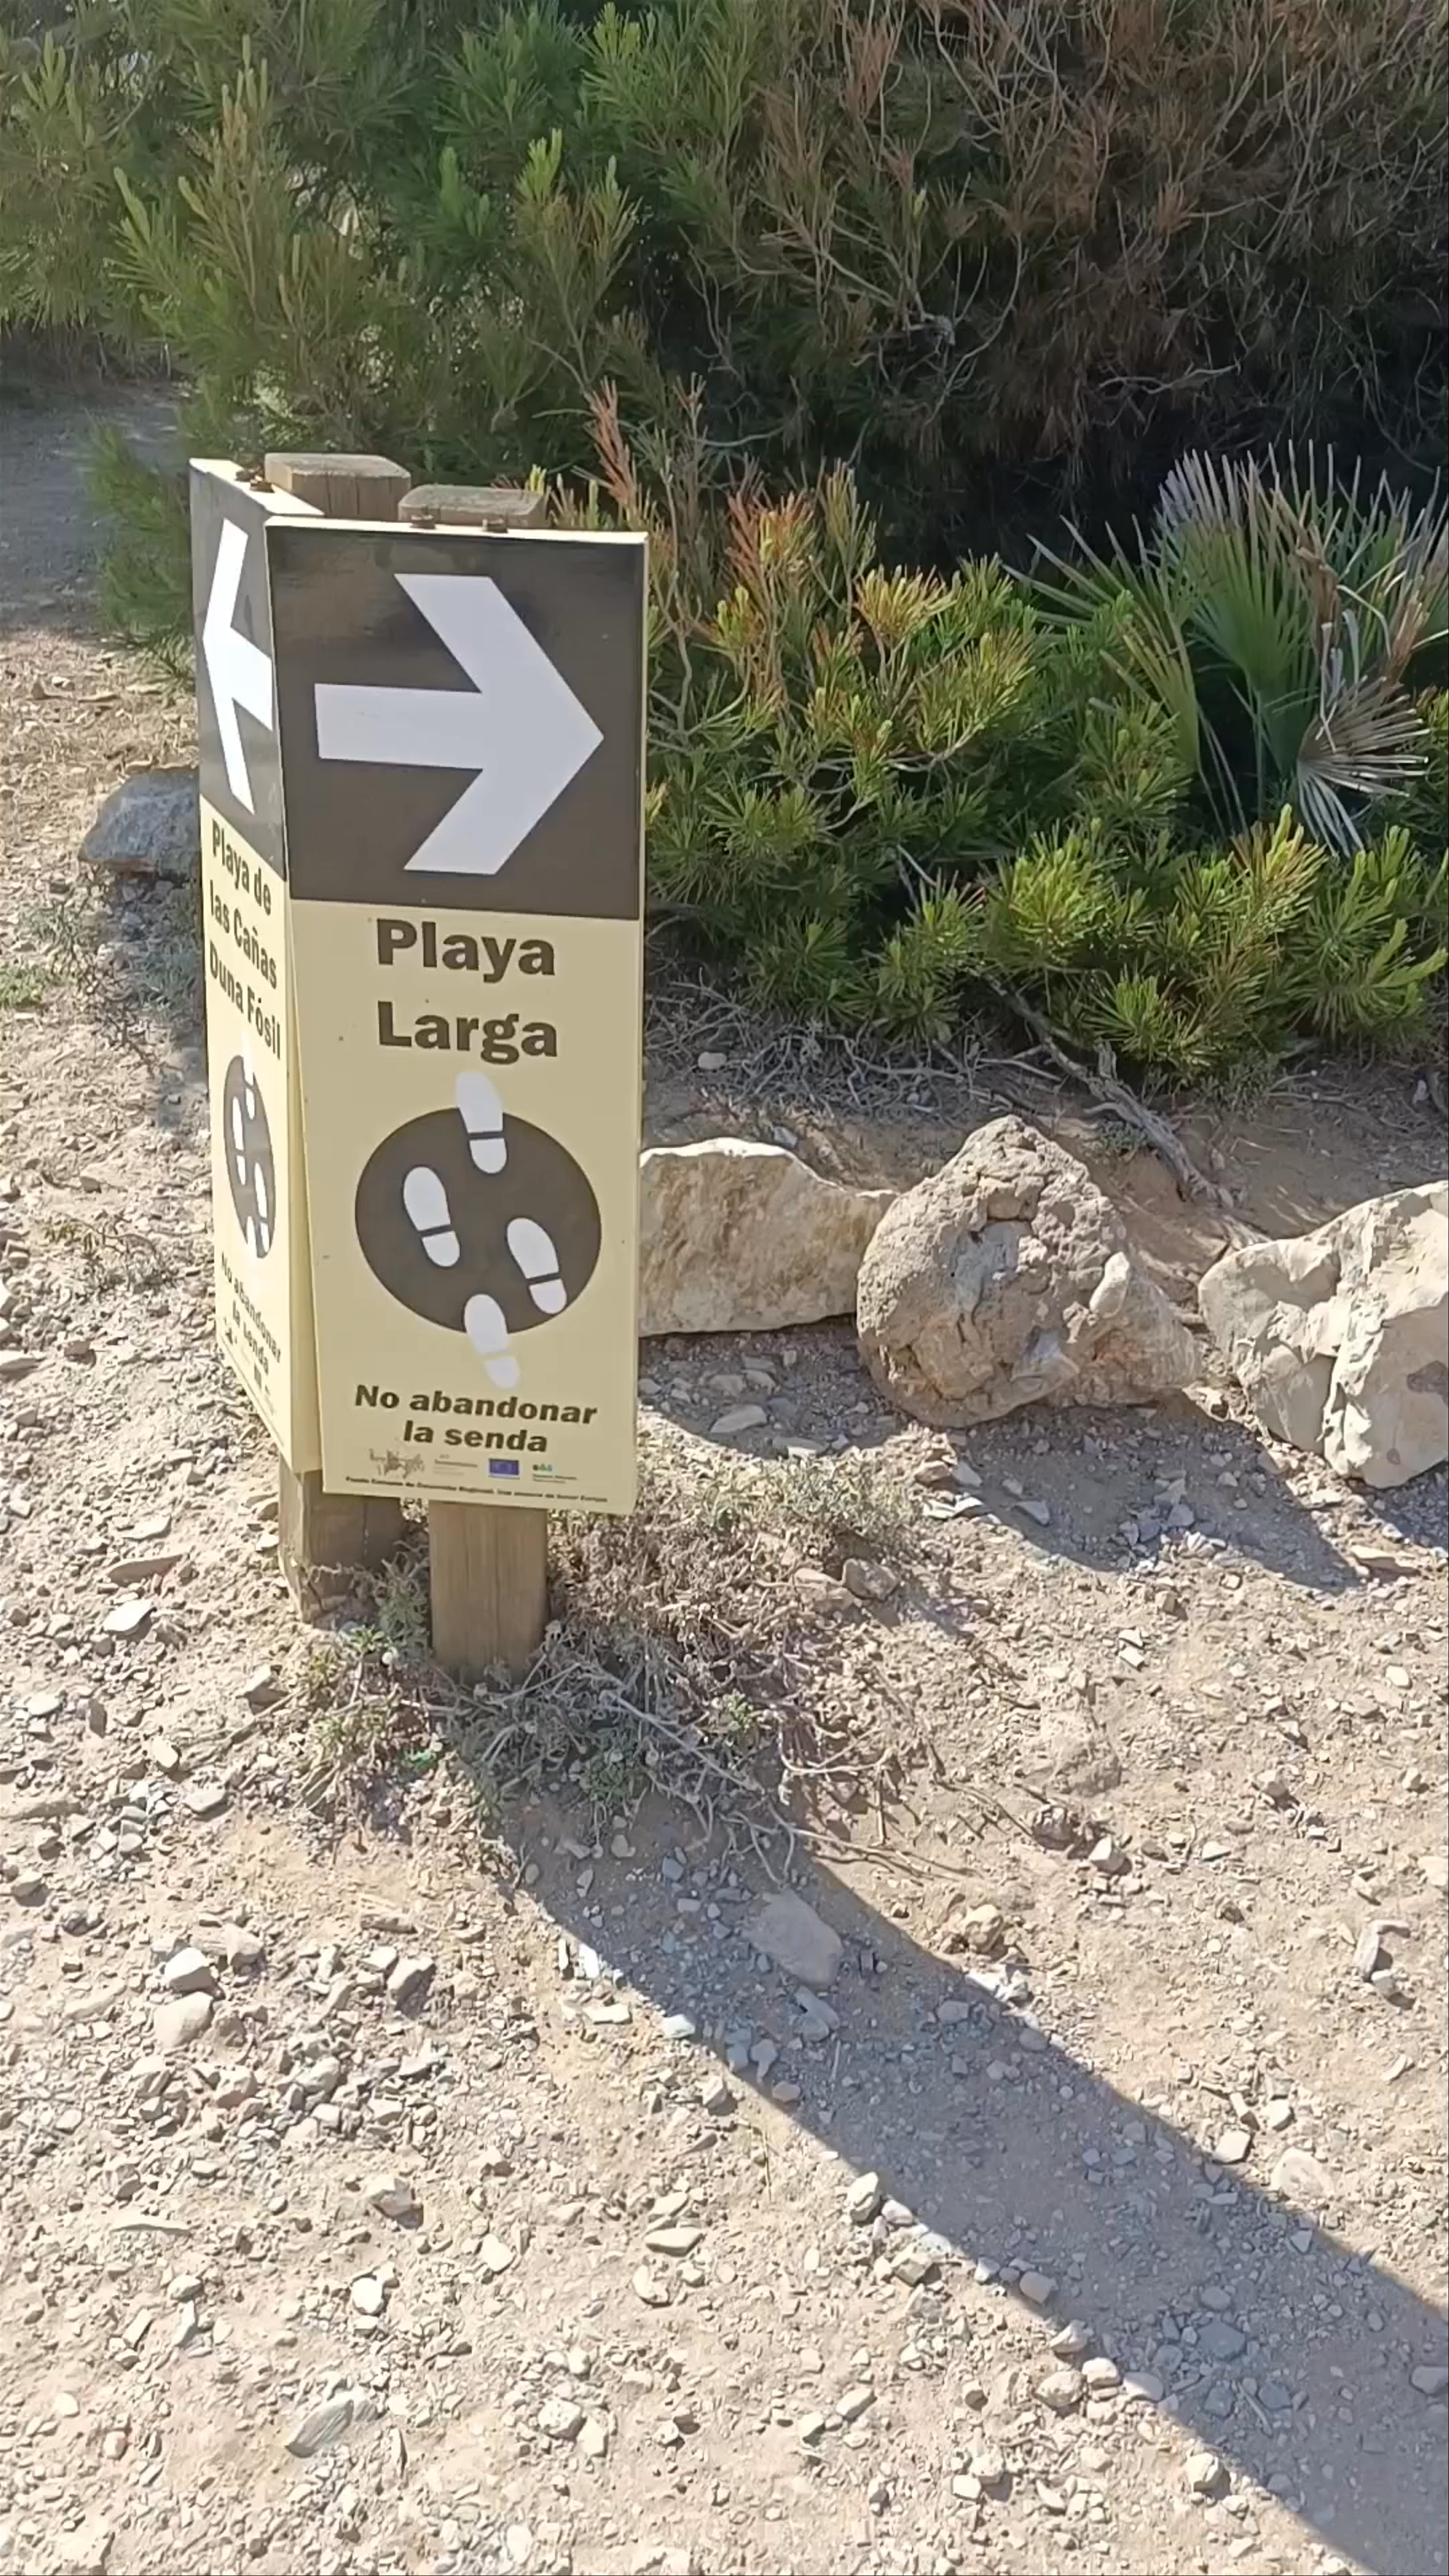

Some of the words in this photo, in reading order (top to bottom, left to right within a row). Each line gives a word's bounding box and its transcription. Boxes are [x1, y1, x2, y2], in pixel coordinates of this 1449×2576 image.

[212, 818, 250, 894] Playa
[254, 867, 271, 916] de
[210, 879, 230, 934] las
[234, 907, 277, 989] Cañas
[377, 918, 555, 983] Playa
[210, 940, 243, 1014] Duna
[247, 985, 280, 1060] Fósil
[377, 1001, 557, 1065] Larga
[355, 1384, 400, 1409] No
[409, 1390, 598, 1424] abandonar
[403, 1420, 434, 1443] la
[444, 1429, 548, 1452] senda
